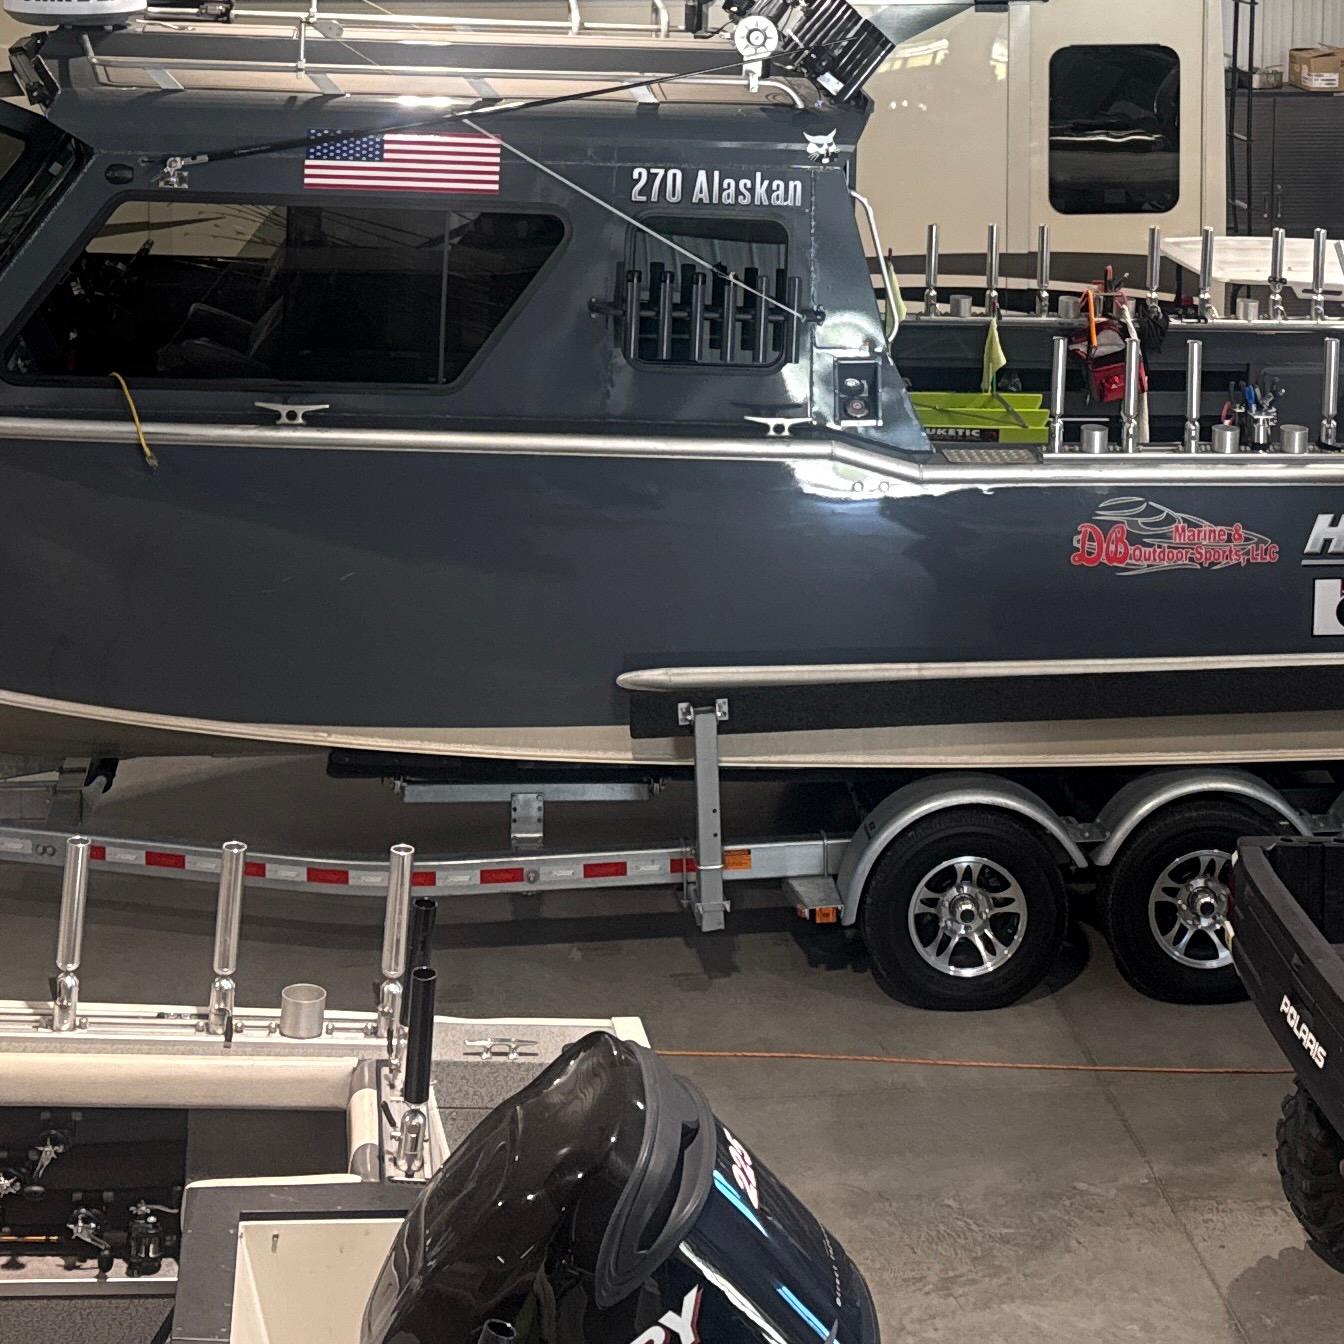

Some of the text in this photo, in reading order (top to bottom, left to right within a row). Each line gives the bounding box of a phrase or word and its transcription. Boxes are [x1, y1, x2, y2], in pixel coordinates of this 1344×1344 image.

[631, 167, 802, 206] 270 Alaskan
[926, 427, 981, 437] UKETIC
[1172, 523, 1244, 544] Marine &
[1132, 544, 1280, 566] Outdoor Sports, LLC
[1280, 994, 1327, 1069] POLARIS
